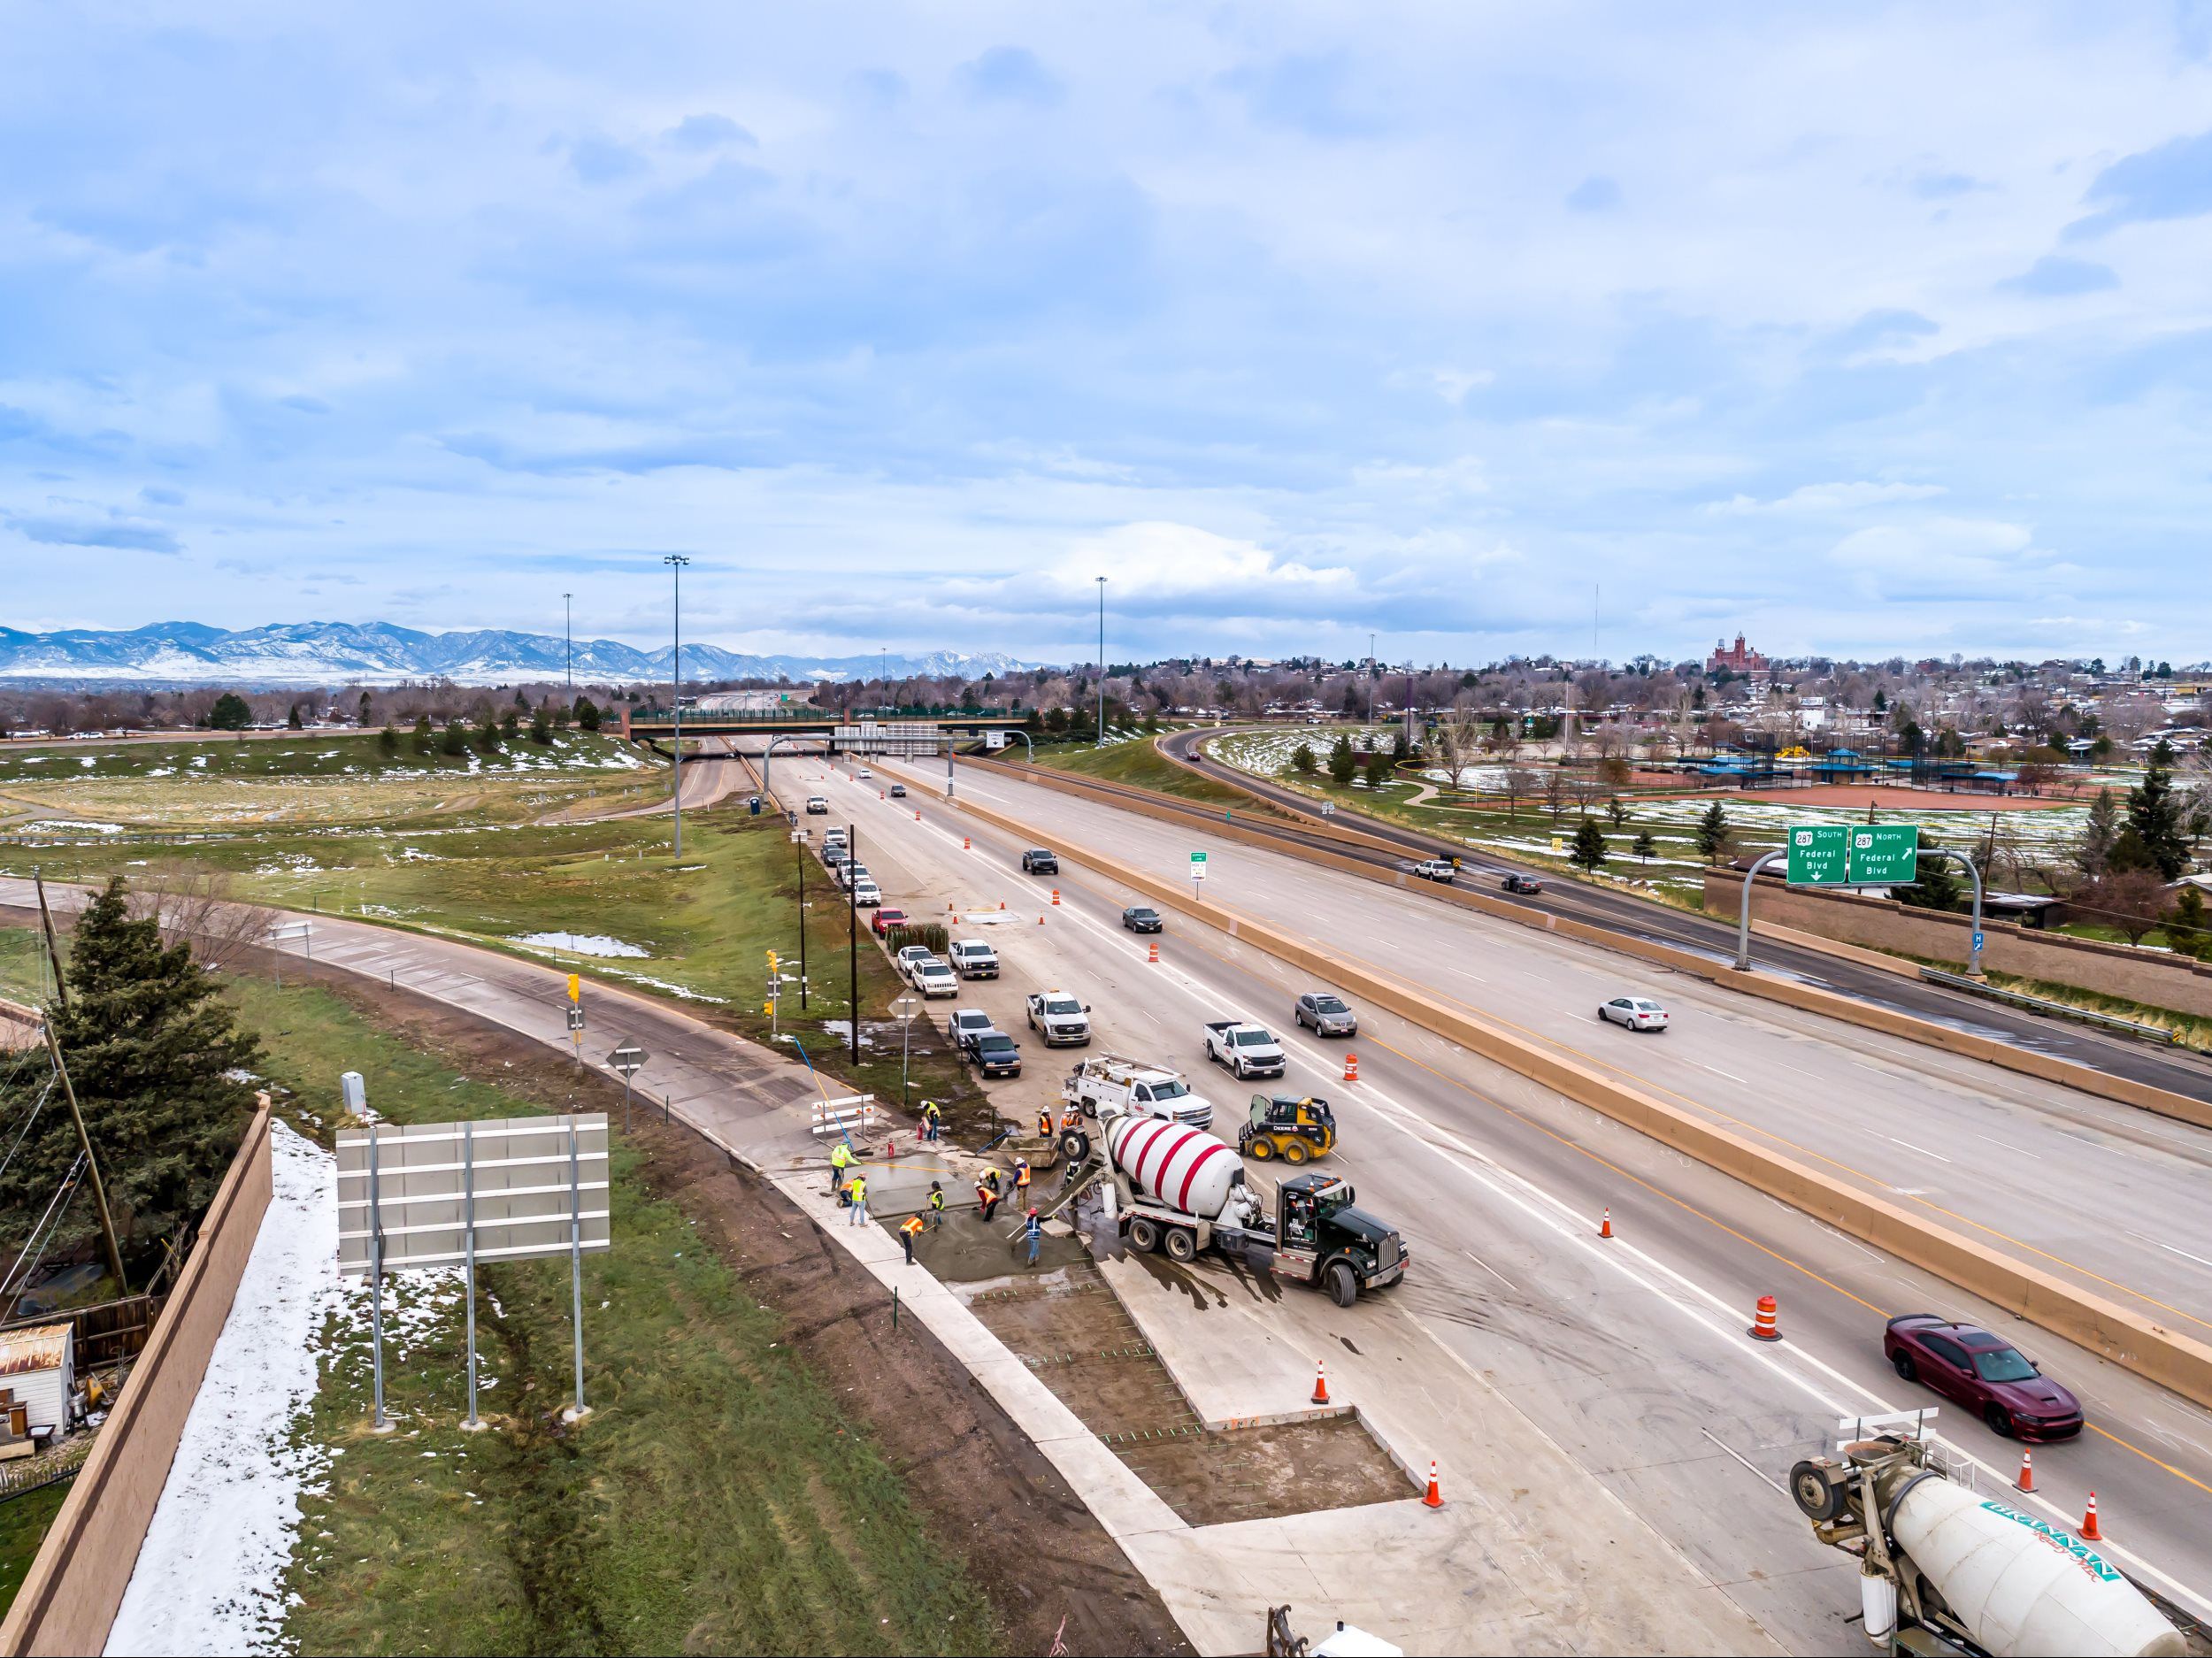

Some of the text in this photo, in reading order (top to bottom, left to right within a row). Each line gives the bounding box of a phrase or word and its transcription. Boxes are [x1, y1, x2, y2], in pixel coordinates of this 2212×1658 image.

[1797, 834, 1811, 843] 287
[1857, 837, 1871, 846] 287
[1800, 849, 1836, 858] Federal
[1807, 861, 1828, 870] Blvd
[1866, 866, 1887, 875] Blvd
[1987, 1501, 2116, 1576] BRANNAN
